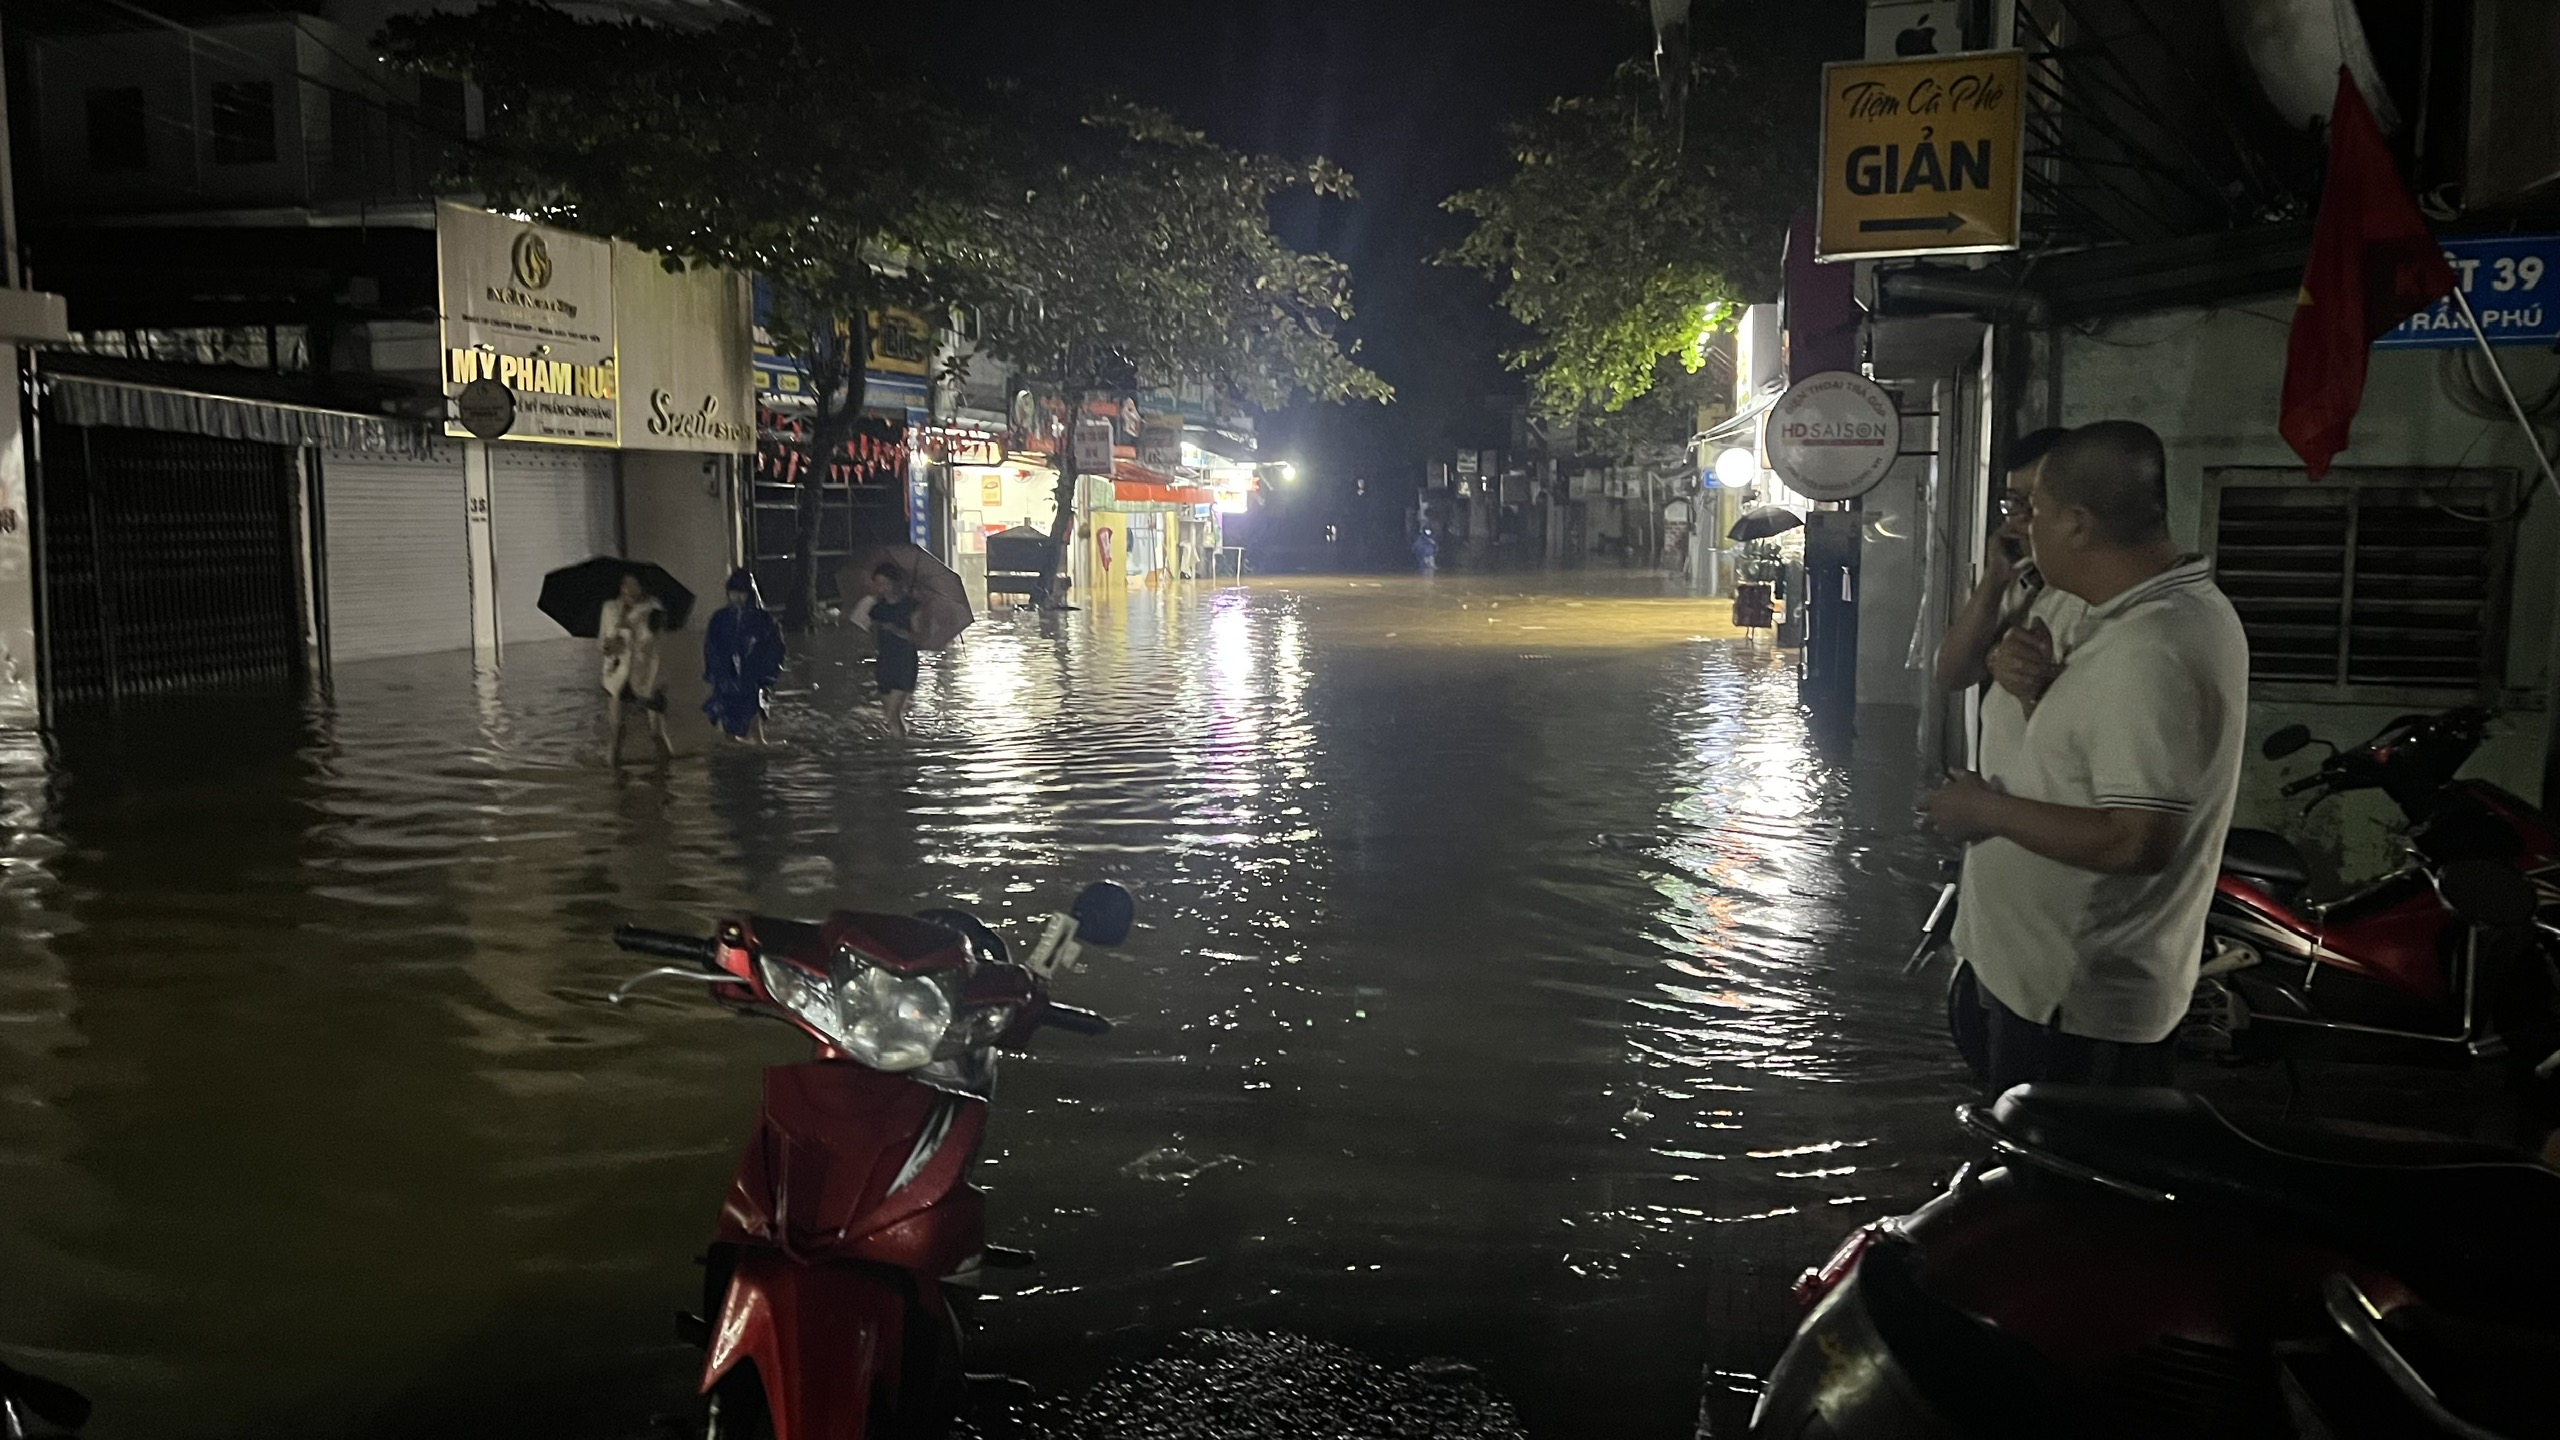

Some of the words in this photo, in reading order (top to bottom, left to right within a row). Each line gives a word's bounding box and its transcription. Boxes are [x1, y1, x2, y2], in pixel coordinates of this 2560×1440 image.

[1841, 81, 1900, 123] Tiệm
[1907, 78, 1943, 115] Cà
[1949, 73, 2005, 112] Phê
[1845, 126, 1991, 196] GIẢN
[2490, 255, 2545, 292] 39
[2482, 302, 2544, 329] PHÚ
[452, 343, 496, 384] MỸ
